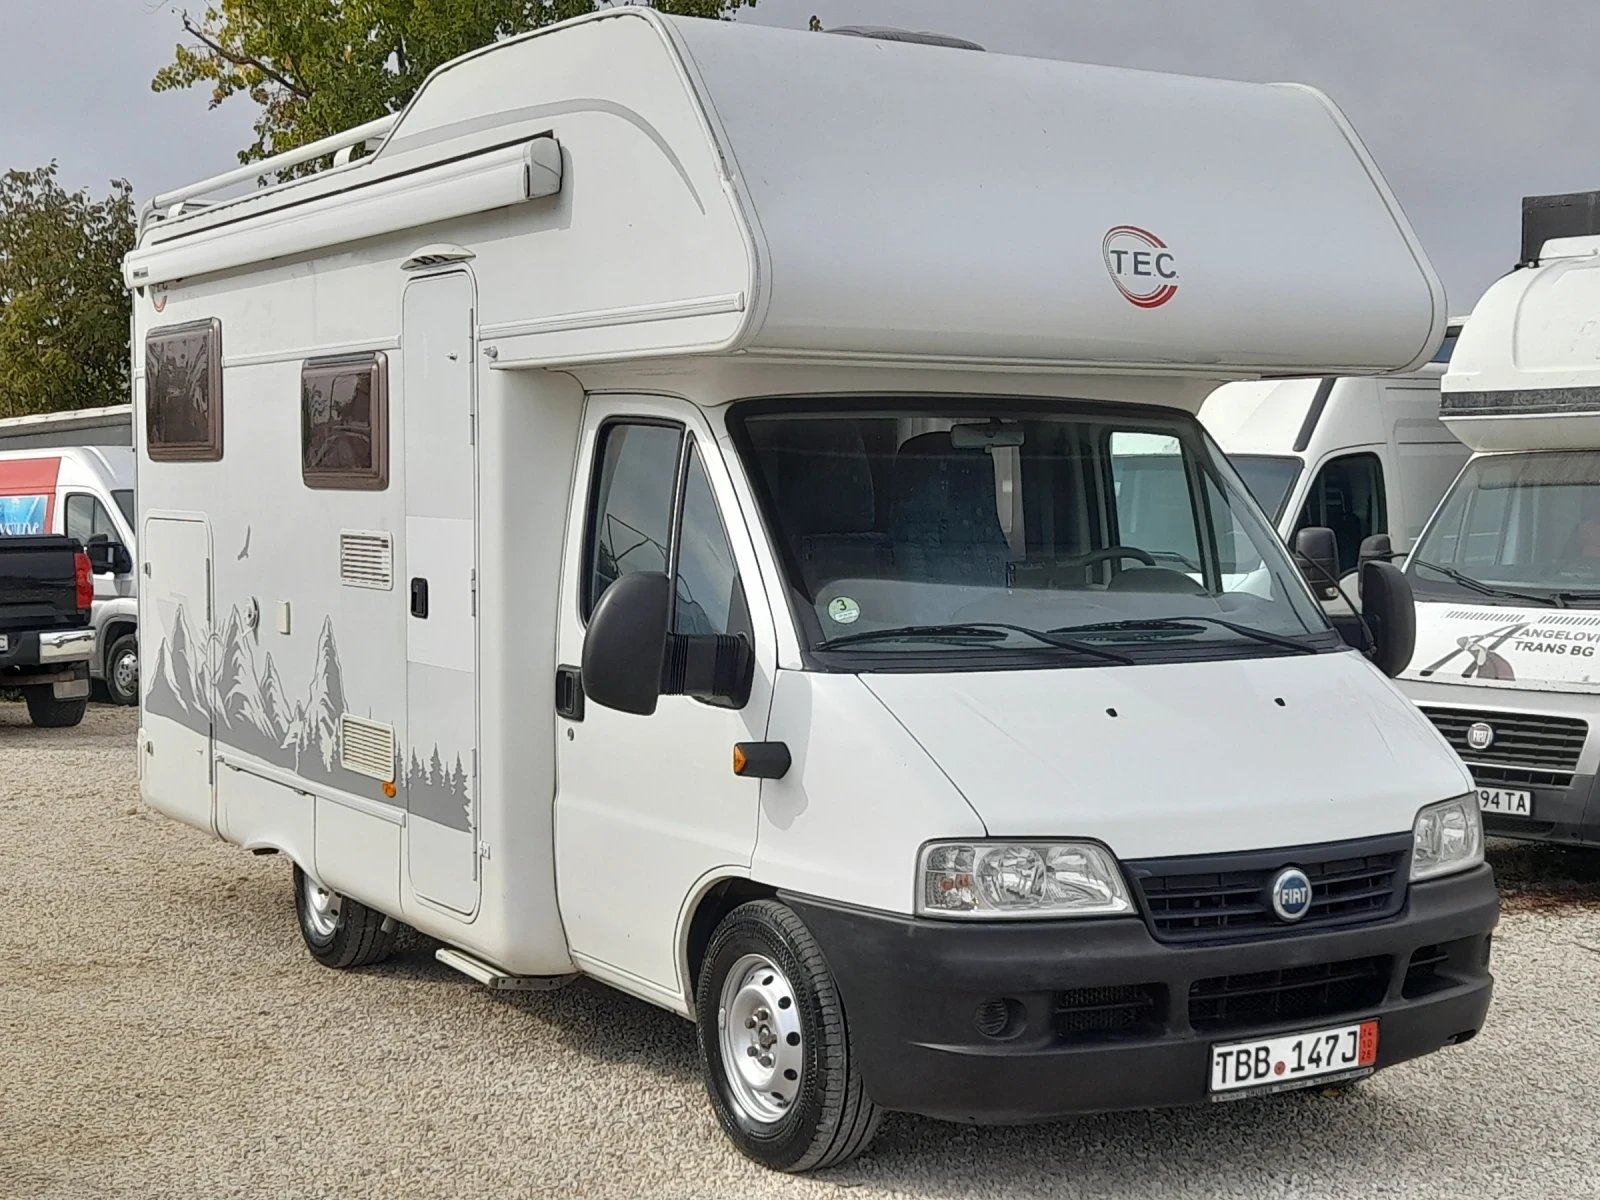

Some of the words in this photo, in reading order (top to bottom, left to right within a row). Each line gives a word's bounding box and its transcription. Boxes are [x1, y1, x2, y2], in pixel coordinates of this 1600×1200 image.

[836, 599, 847, 611] 3
[1515, 641, 1567, 654] TRANS
[1570, 645, 1595, 657] BG
[1480, 790, 1500, 809] 94
[1504, 792, 1526, 812] TA
[1281, 887, 1307, 905] FIAT
[1217, 1046, 1270, 1083] TBB
